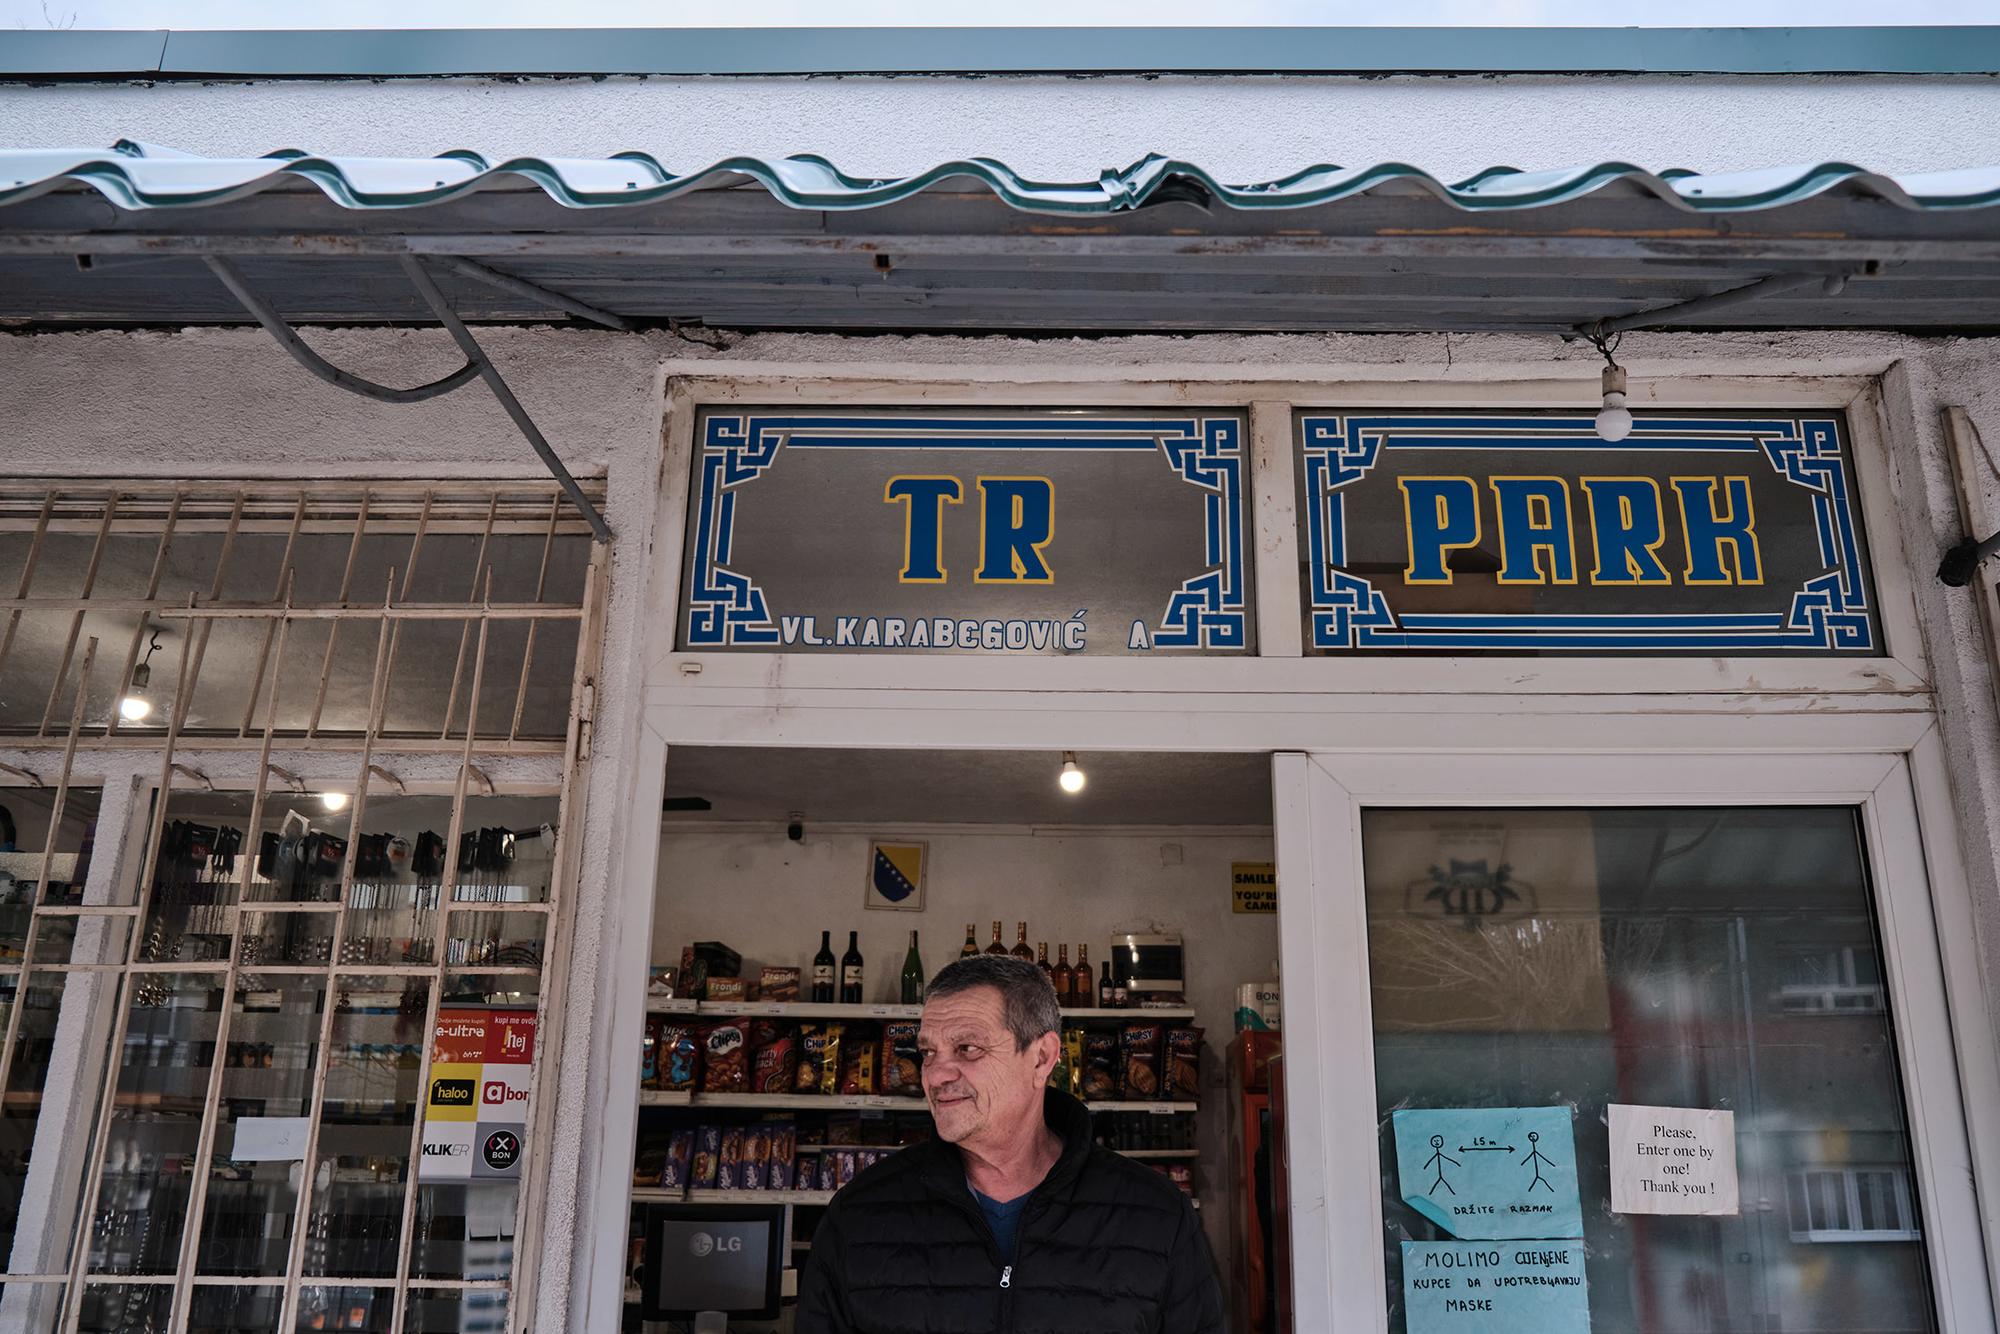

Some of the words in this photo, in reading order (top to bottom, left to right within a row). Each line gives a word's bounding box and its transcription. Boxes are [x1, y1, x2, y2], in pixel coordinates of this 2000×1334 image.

[884, 475, 1055, 584] TR
[1397, 476, 1764, 585] PARK
[1127, 620, 1151, 650] A
[1235, 873, 1275, 884] SMILE
[495, 1016, 508, 1025] kupi
[438, 1087, 468, 1099] haloo
[422, 1144, 470, 1156] KLIKER
[492, 1151, 511, 1159] BON
[1636, 1142, 1670, 1155] Enter
[1673, 1147, 1696, 1157] one
[1699, 1145, 1714, 1160] by
[1662, 1163, 1690, 1175] one!
[1640, 1179, 1680, 1193] Thank
[1683, 1184, 1706, 1196] you
[1453, 1204, 1495, 1215] DRŽITE
[1510, 1205, 1553, 1214] RAZMAK
[717, 1237, 742, 1251] LG
[1425, 1250, 1500, 1268] MOLIMO
[1413, 1278, 1451, 1289] KUPCE
[1467, 1278, 1481, 1288] DA
[1446, 1299, 1493, 1313] MASKE
